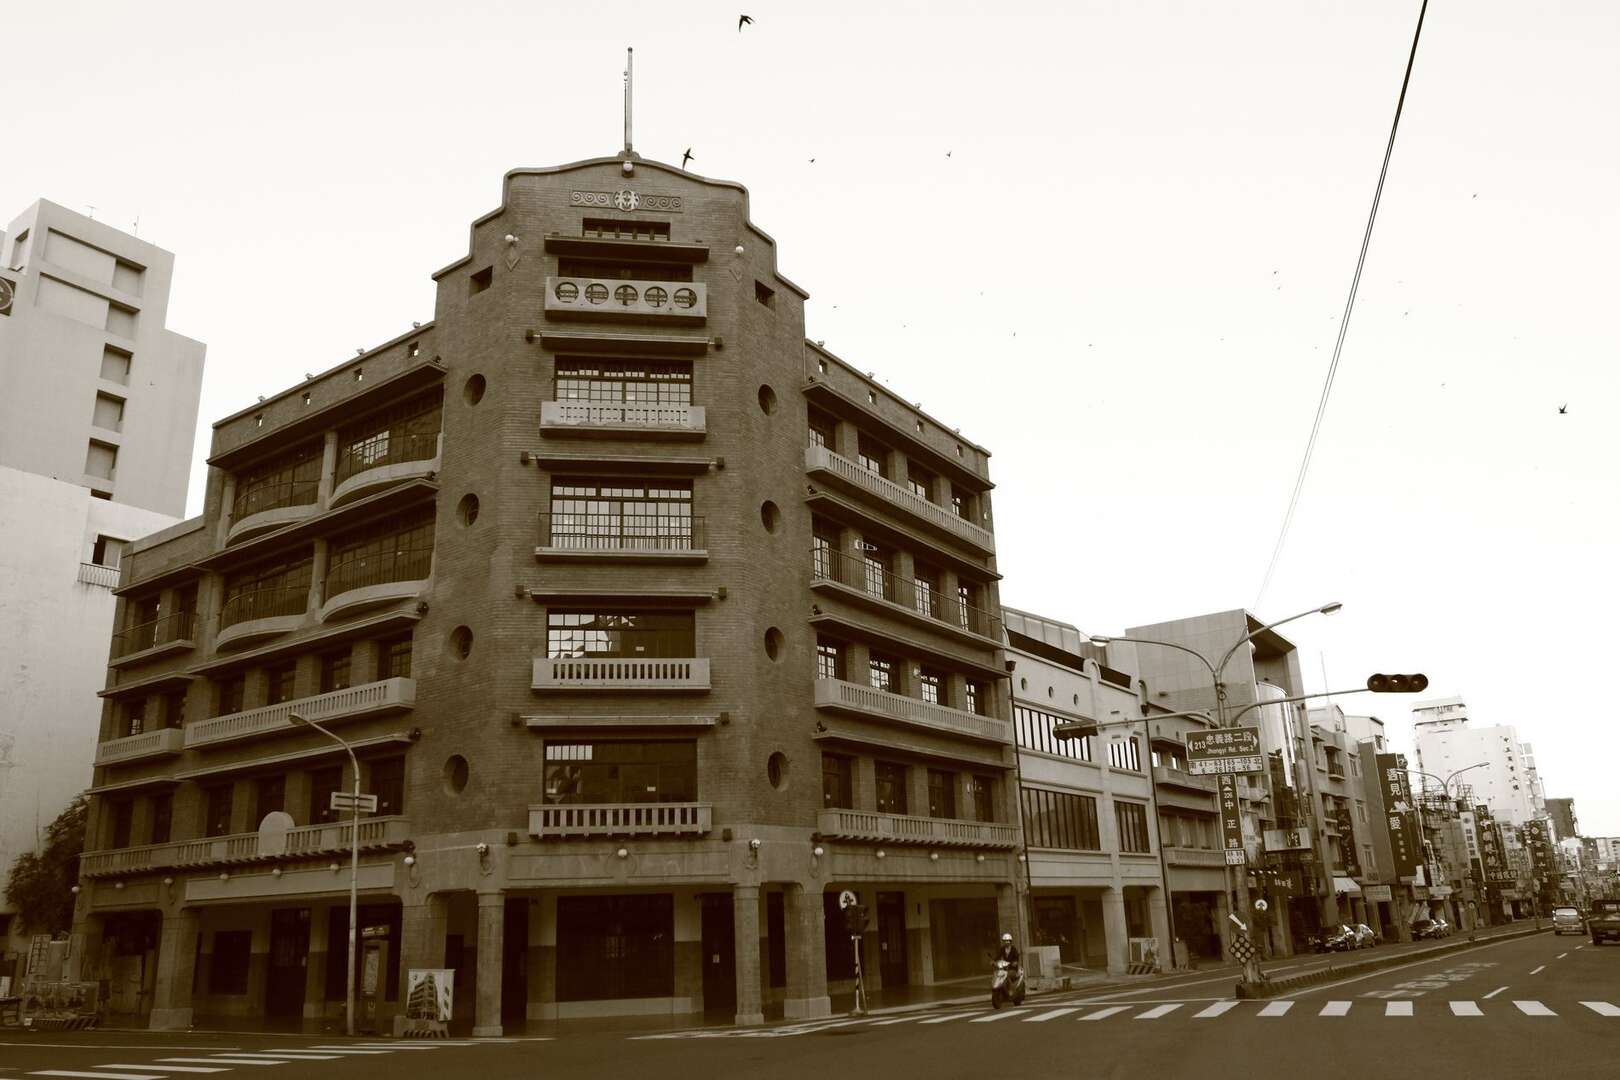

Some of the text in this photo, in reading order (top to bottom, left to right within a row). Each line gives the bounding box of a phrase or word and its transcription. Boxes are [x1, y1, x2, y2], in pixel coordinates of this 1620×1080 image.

[1194, 732, 1252, 750] 213 忠義路二段
[1224, 800, 1238, 848] 中正路
